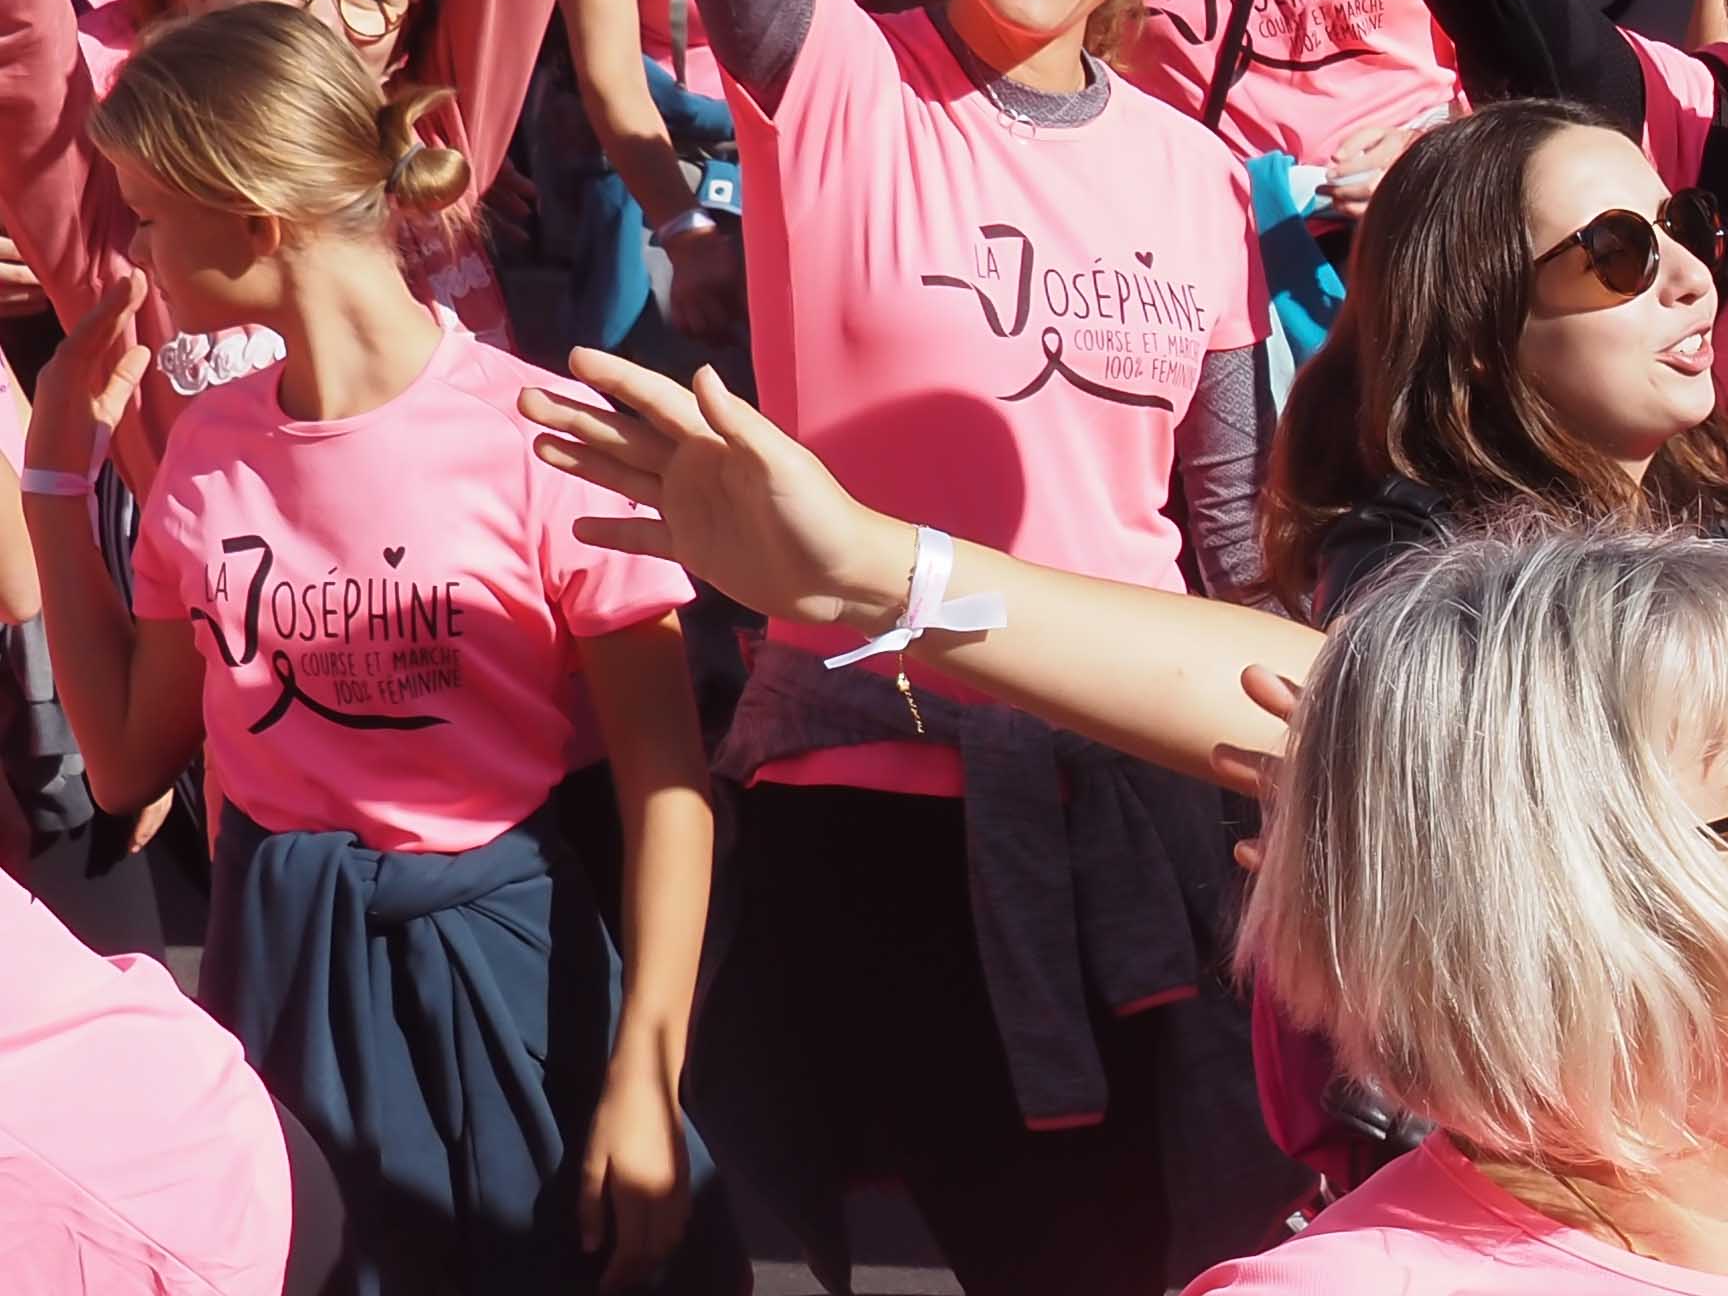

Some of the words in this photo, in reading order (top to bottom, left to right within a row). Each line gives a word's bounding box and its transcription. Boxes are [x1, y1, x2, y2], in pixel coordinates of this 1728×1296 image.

[921, 223, 1206, 338] JOSÉPHINE
[974, 243, 1001, 281] LA
[1073, 328, 1134, 354] COURSE
[1142, 333, 1159, 353] ET
[1104, 356, 1144, 381] 100%
[190, 534, 465, 667] JOSÉPHINE
[204, 561, 230, 603] LA
[300, 651, 357, 679] COURSE
[364, 652, 383, 677] ET
[391, 646, 463, 670] MARCHE
[334, 678, 371, 707] 100%
[377, 667, 464, 706] FÉMININE
